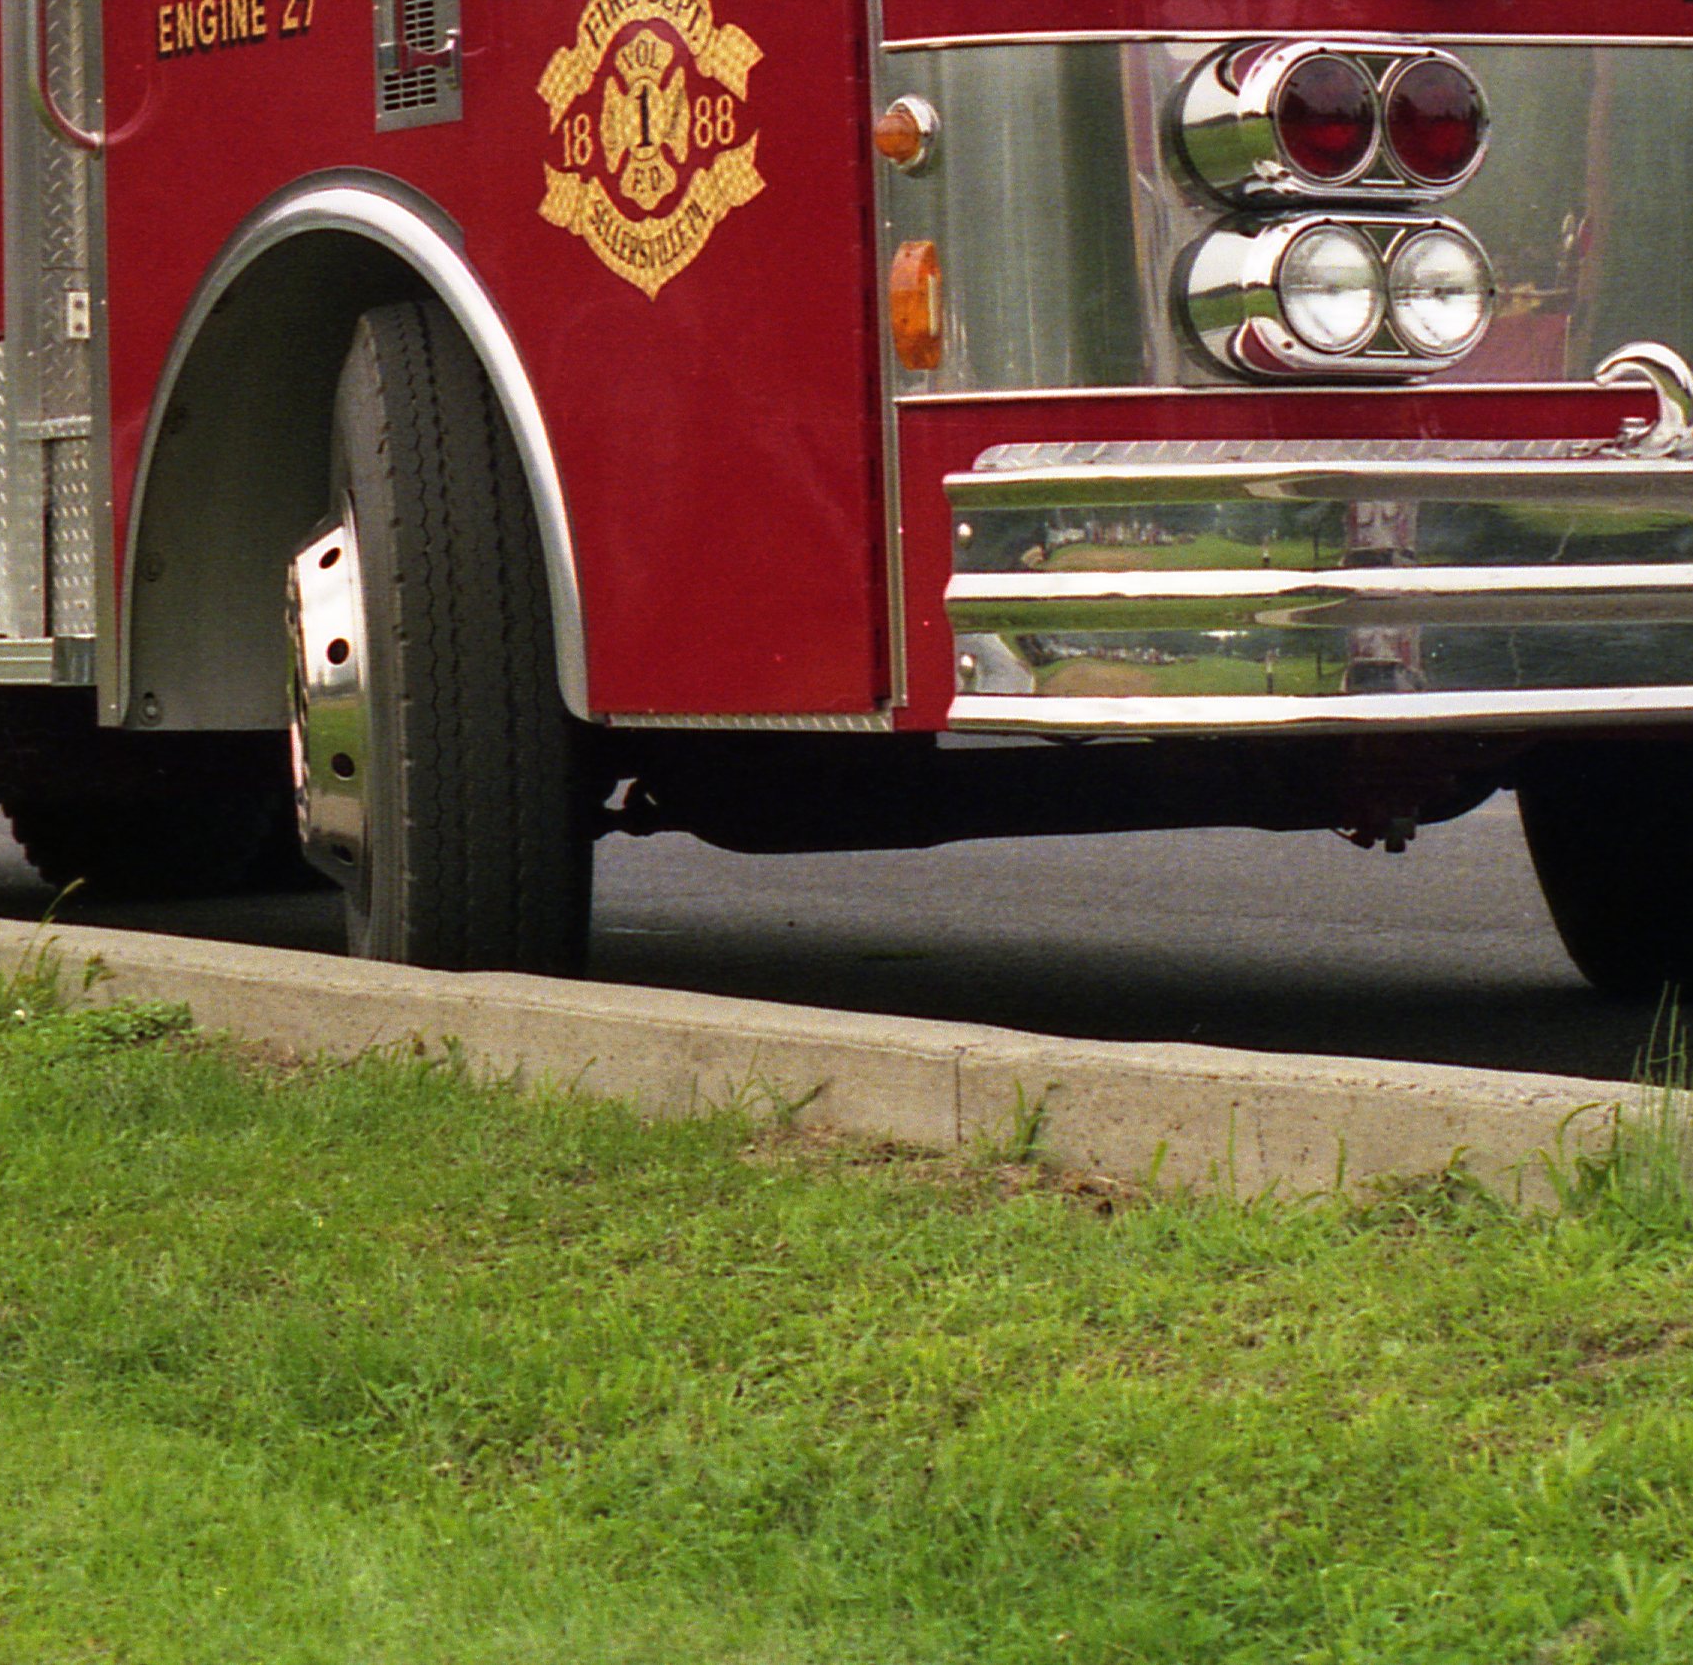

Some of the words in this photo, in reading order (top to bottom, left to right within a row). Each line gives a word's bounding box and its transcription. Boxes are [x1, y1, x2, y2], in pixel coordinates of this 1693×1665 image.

[562, 113, 593, 168] 18
[694, 95, 736, 149] 88
[634, 85, 654, 148] 1
